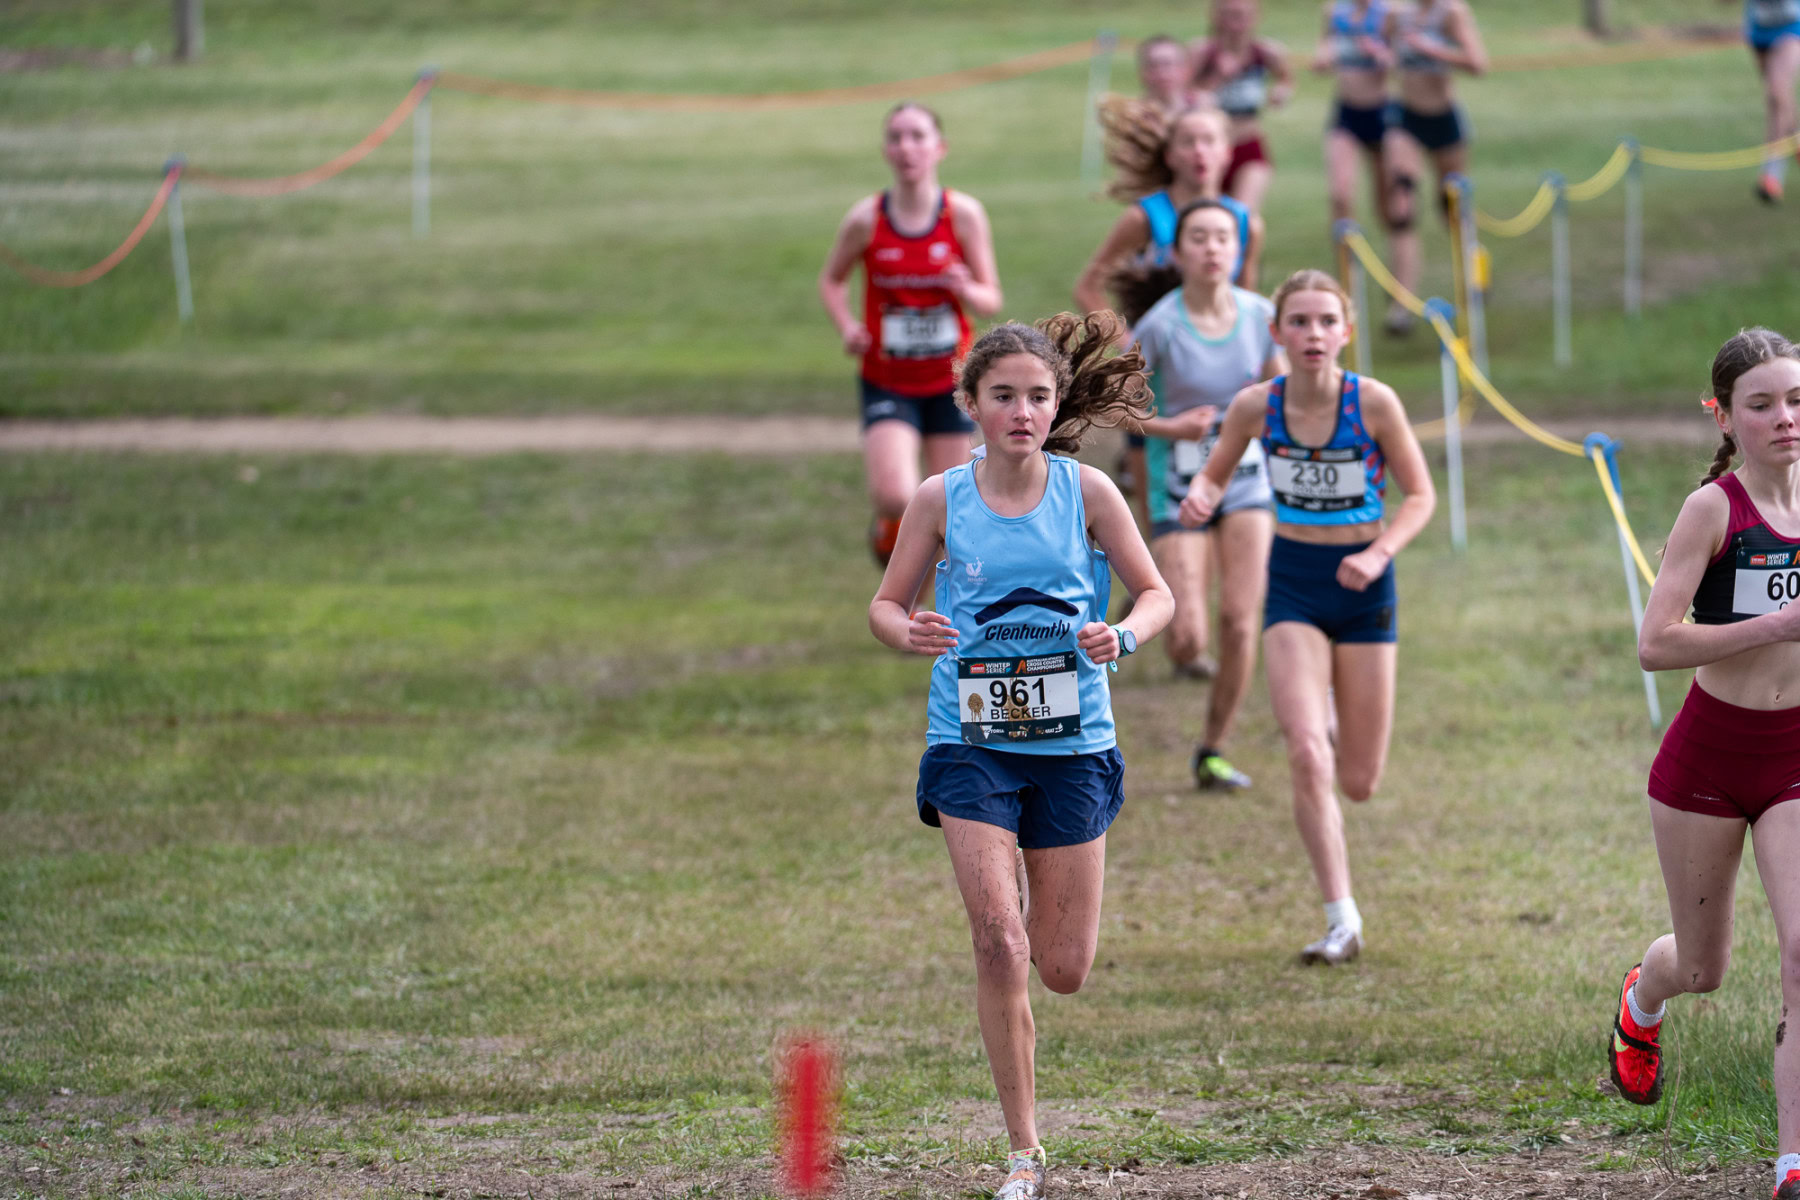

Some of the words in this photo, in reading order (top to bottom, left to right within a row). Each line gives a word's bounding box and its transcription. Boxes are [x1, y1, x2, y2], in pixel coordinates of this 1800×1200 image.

[1291, 463, 1338, 486] 230
[1767, 571, 1800, 601] 60
[985, 619, 1070, 641] Glenhuntly
[1027, 663, 1065, 672] CHAMPIONSHIPS
[989, 677, 1046, 708] 961
[990, 706, 1051, 720] BECKER
